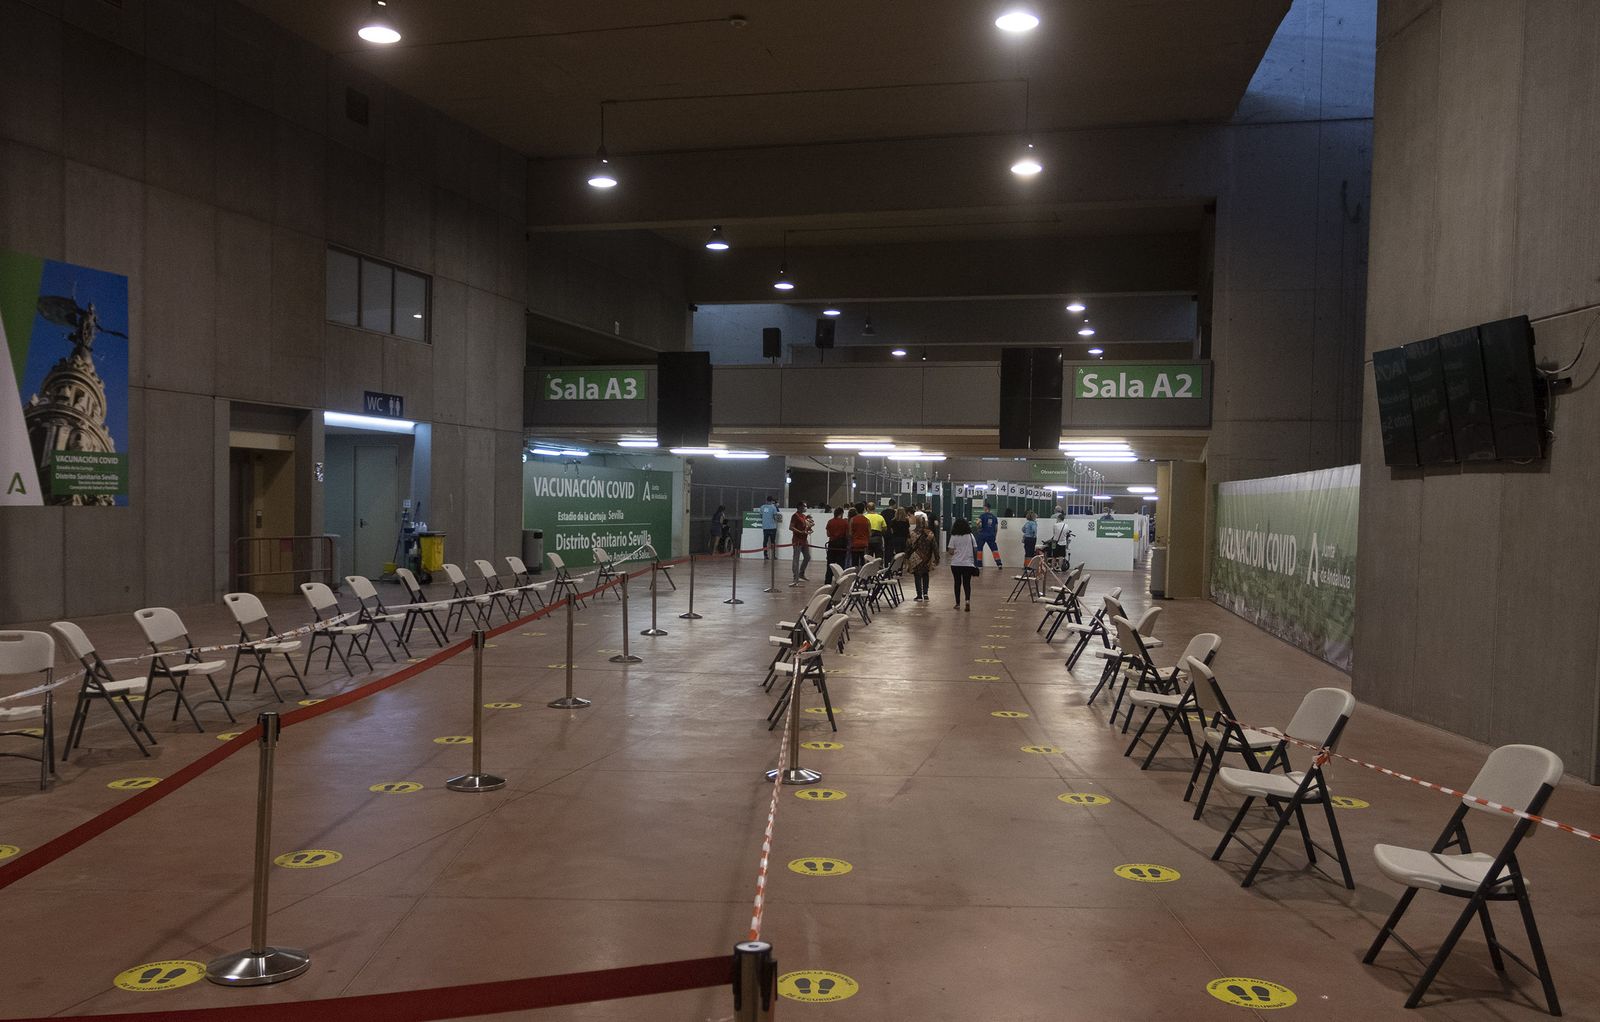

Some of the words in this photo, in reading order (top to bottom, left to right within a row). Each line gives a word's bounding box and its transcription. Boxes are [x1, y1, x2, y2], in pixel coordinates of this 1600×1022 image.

[550, 377, 599, 400] Sala
[604, 378, 637, 400] A3
[1082, 372, 1144, 398] Sala
[1150, 373, 1192, 398] A2
[367, 395, 383, 412] WC
[55, 455, 98, 464] VACUNACIÓN
[533, 476, 604, 498] VACUNACIÓN
[606, 481, 635, 499] COVID
[558, 512, 576, 520] Estadio
[577, 512, 584, 520] de
[584, 512, 589, 520] la
[590, 512, 606, 522] Cartuja
[608, 510, 624, 520] Sevilla
[556, 534, 590, 550] Distrito
[591, 532, 627, 548] Sanitario
[628, 530, 652, 546] Sevilla
[1220, 523, 1265, 568] VACUNACIÓN
[1267, 532, 1296, 576] COVID
